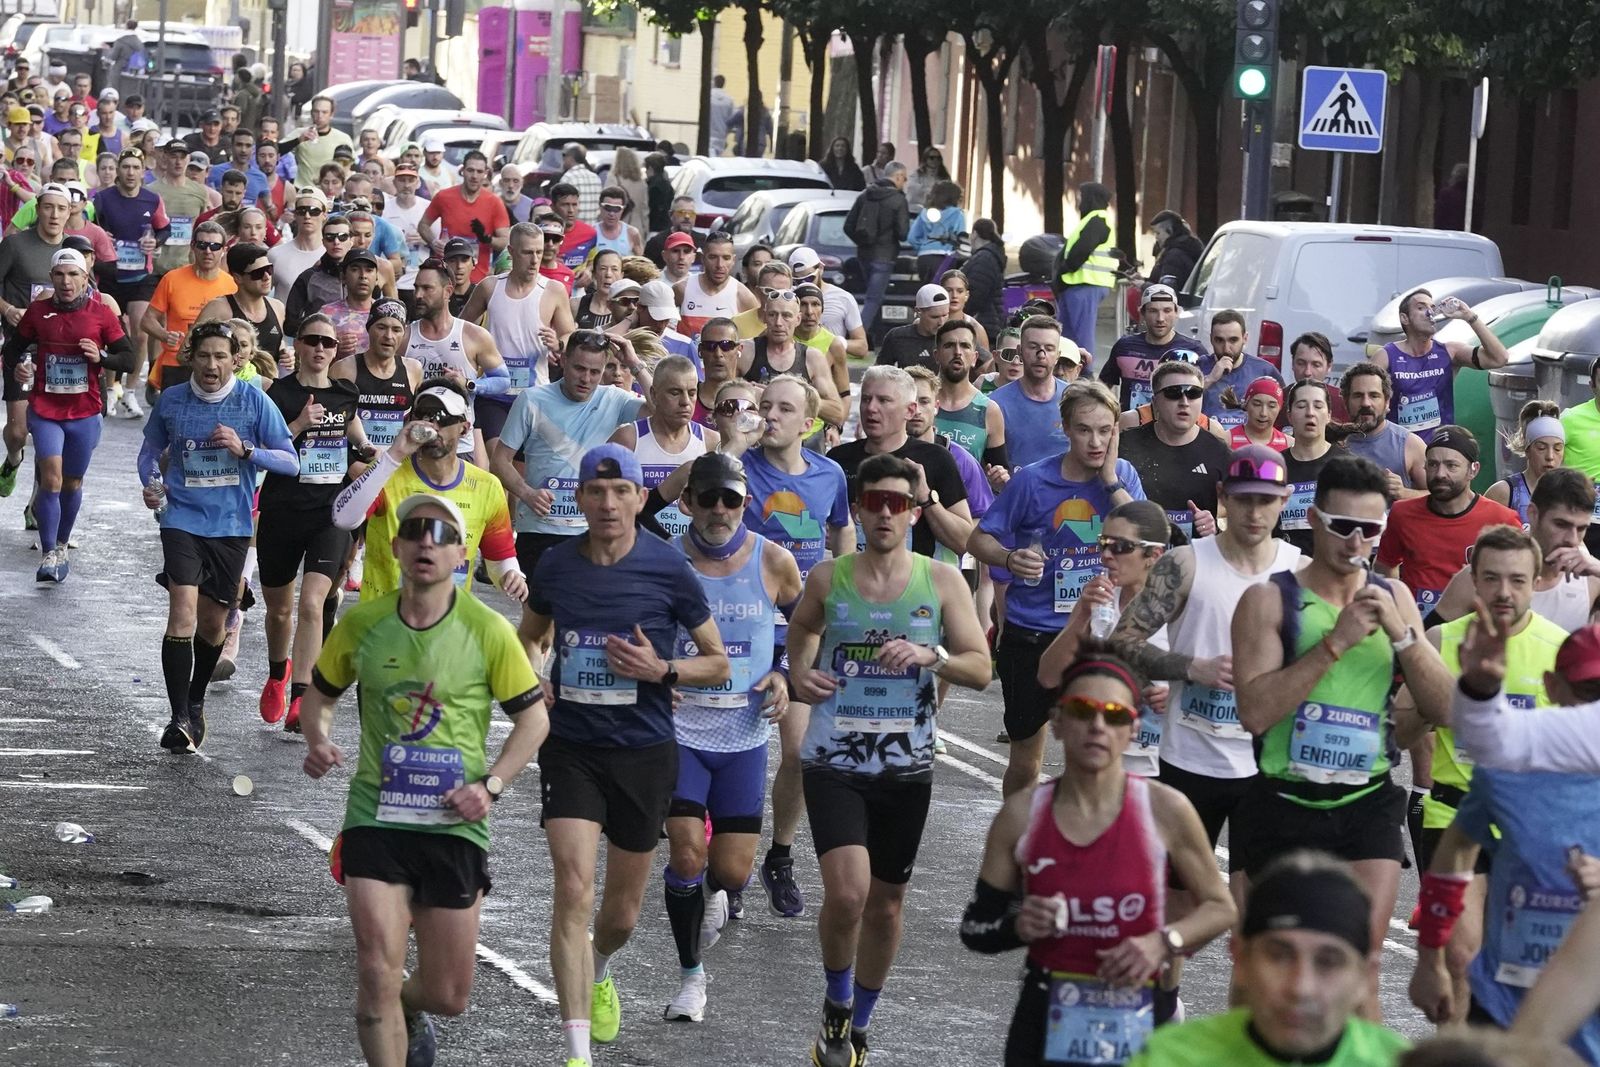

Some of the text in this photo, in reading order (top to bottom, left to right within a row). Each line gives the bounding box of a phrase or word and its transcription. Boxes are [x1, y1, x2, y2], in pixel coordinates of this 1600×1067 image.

[1394, 368, 1445, 379] TROTASIERRA
[1411, 391, 1434, 402] ZURICH
[212, 467, 239, 476] BLANCA
[308, 463, 340, 473] HELENE
[1281, 509, 1306, 518] MAGD
[577, 671, 615, 687] FRED
[864, 686, 888, 697] 8996
[836, 704, 914, 717] ANDRÉS FREYRE
[1189, 698, 1239, 720] ANTOIN
[1326, 709, 1372, 728] ZURICH
[1324, 733, 1351, 747] 5979
[410, 751, 459, 763] ZURICH
[408, 773, 440, 786] 16220
[379, 790, 448, 808] DURANOSE
[1529, 893, 1585, 910] ZURIC
